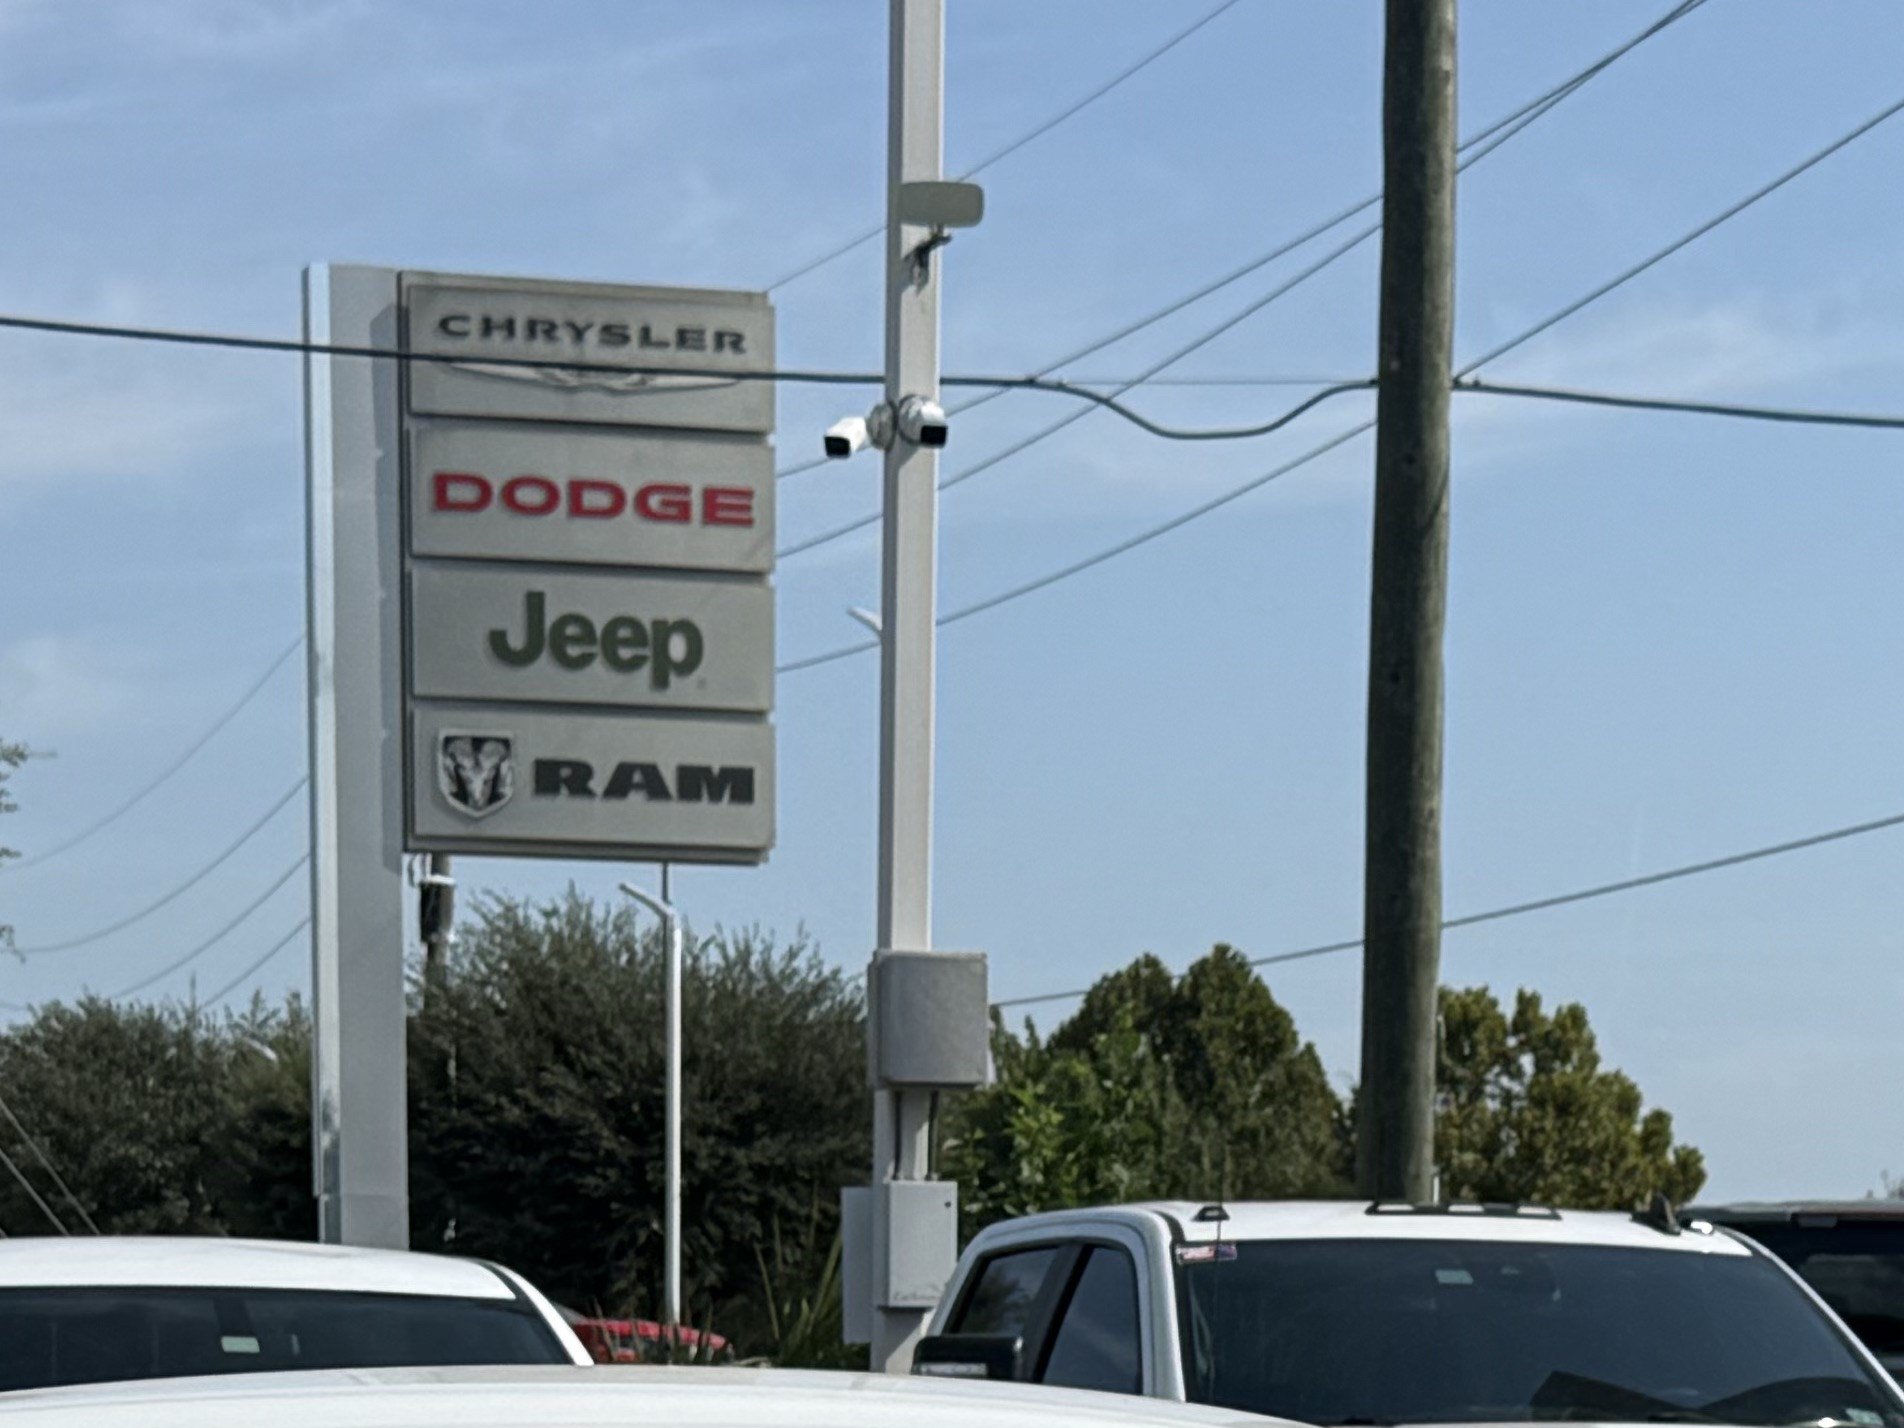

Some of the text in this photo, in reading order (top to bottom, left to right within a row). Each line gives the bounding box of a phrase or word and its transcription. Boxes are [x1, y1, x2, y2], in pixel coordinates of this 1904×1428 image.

[437, 314, 746, 354] CHRYSLER
[432, 473, 755, 527] DODGE
[488, 590, 704, 691] Jeep
[534, 758, 755, 805] RAM
